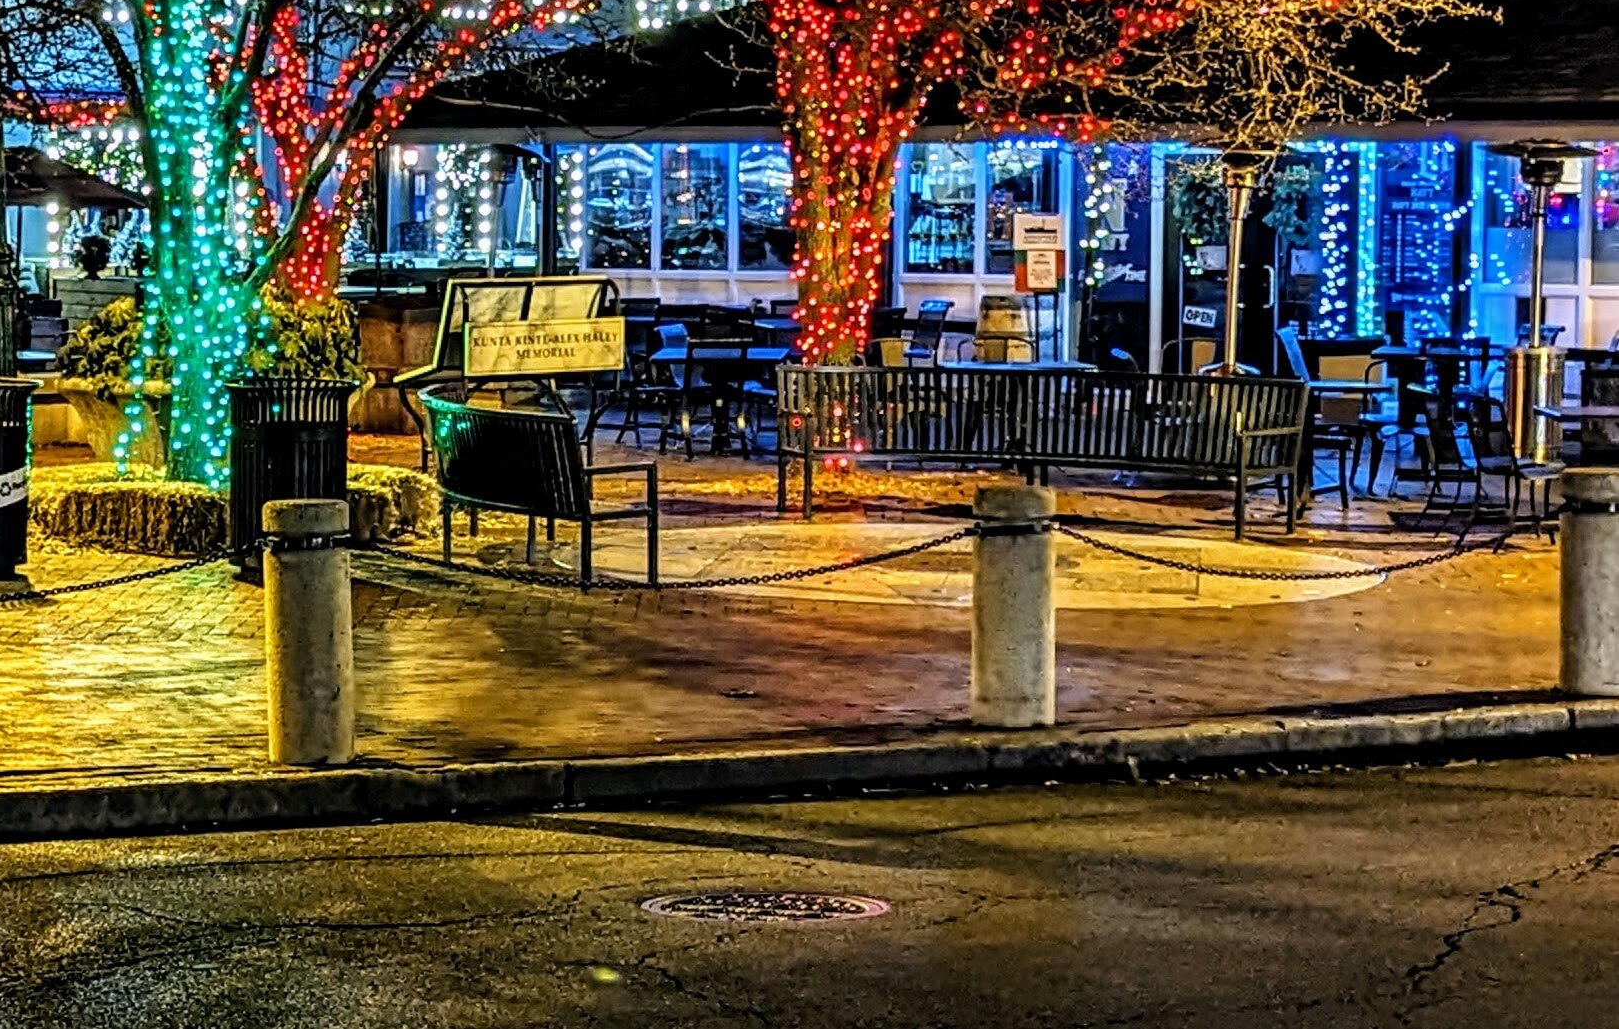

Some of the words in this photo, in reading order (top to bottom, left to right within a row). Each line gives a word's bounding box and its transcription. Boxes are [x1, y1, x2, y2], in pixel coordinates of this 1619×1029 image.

[1185, 308, 1214, 324] OPEN
[473, 336, 511, 347] KUNTA
[583, 331, 618, 343] HALEY
[516, 348, 577, 360] MEMORIAL
